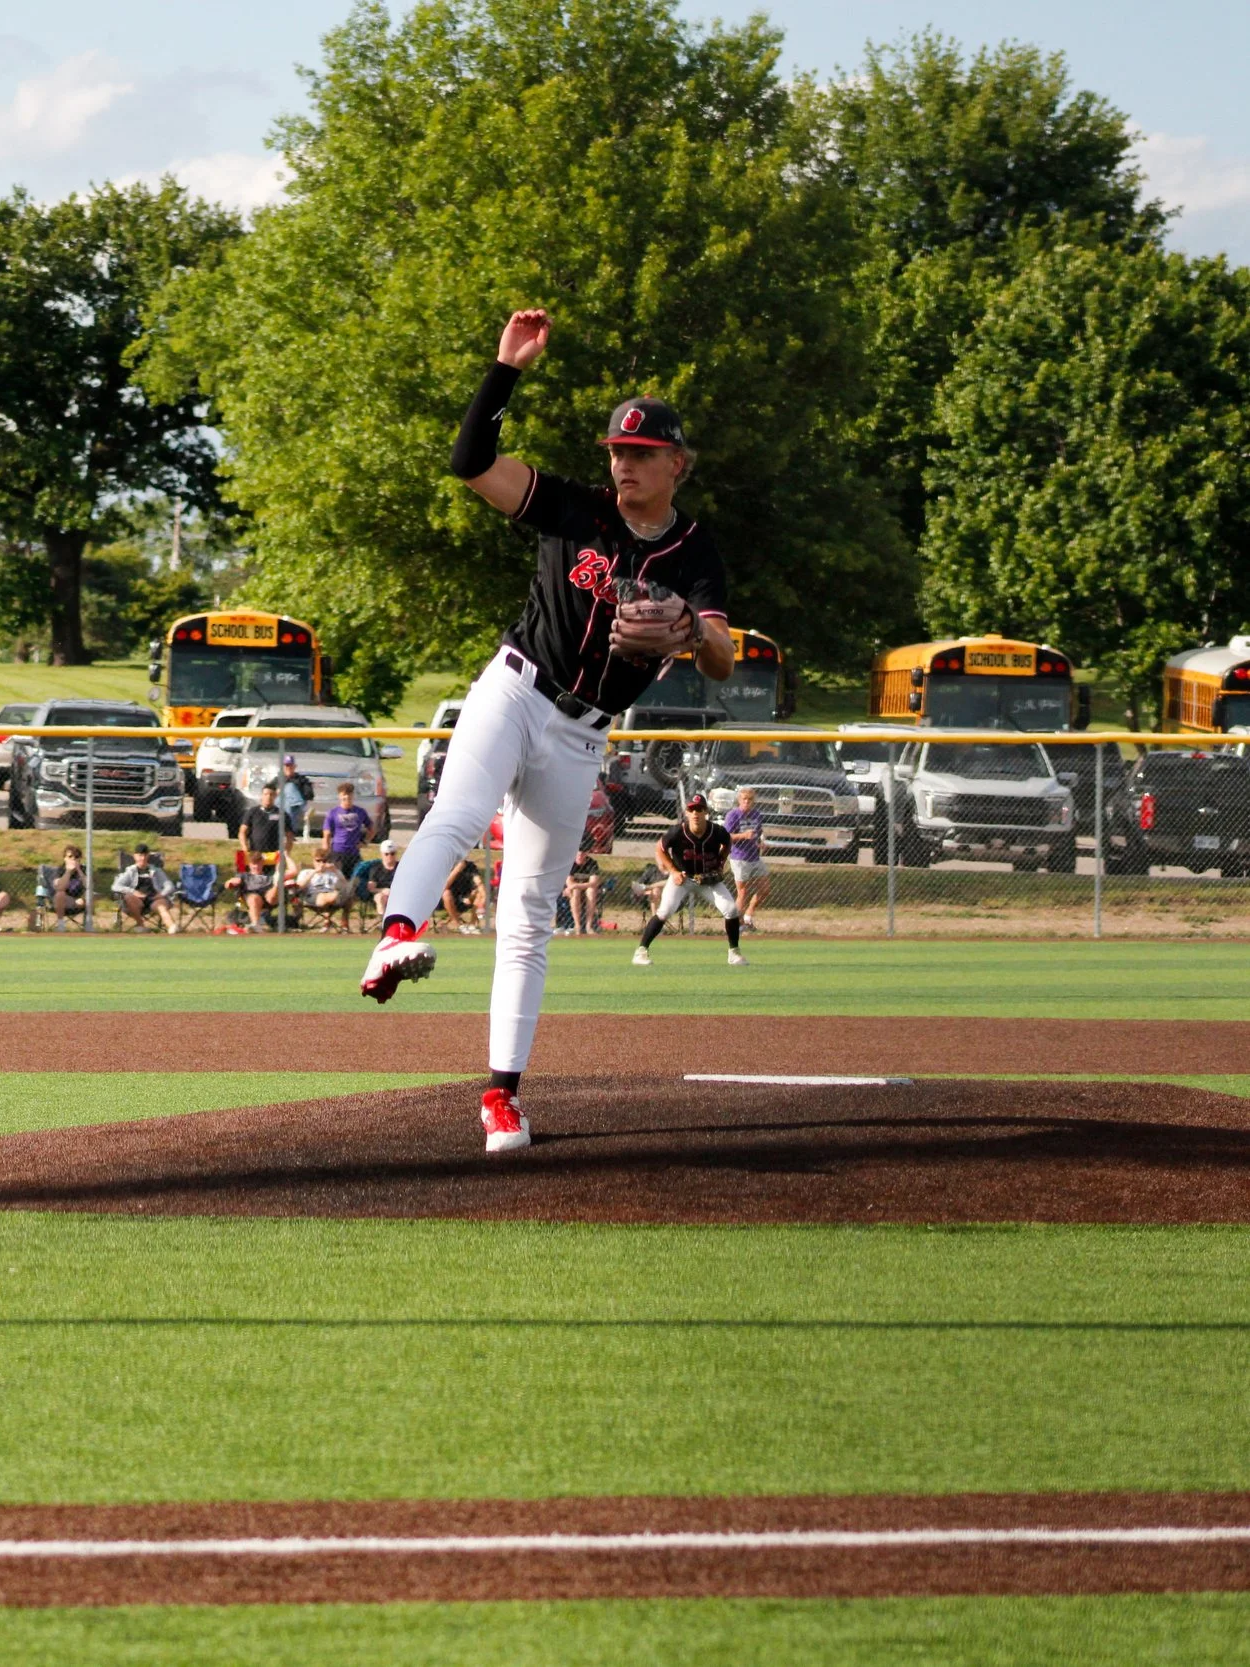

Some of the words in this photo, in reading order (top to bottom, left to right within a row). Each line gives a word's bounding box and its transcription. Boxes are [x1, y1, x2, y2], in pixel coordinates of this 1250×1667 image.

[211, 623, 249, 639] SCHOOL
[254, 626, 274, 640] BUS
[969, 652, 1007, 667] SCHOOL
[1011, 654, 1032, 668] BUS
